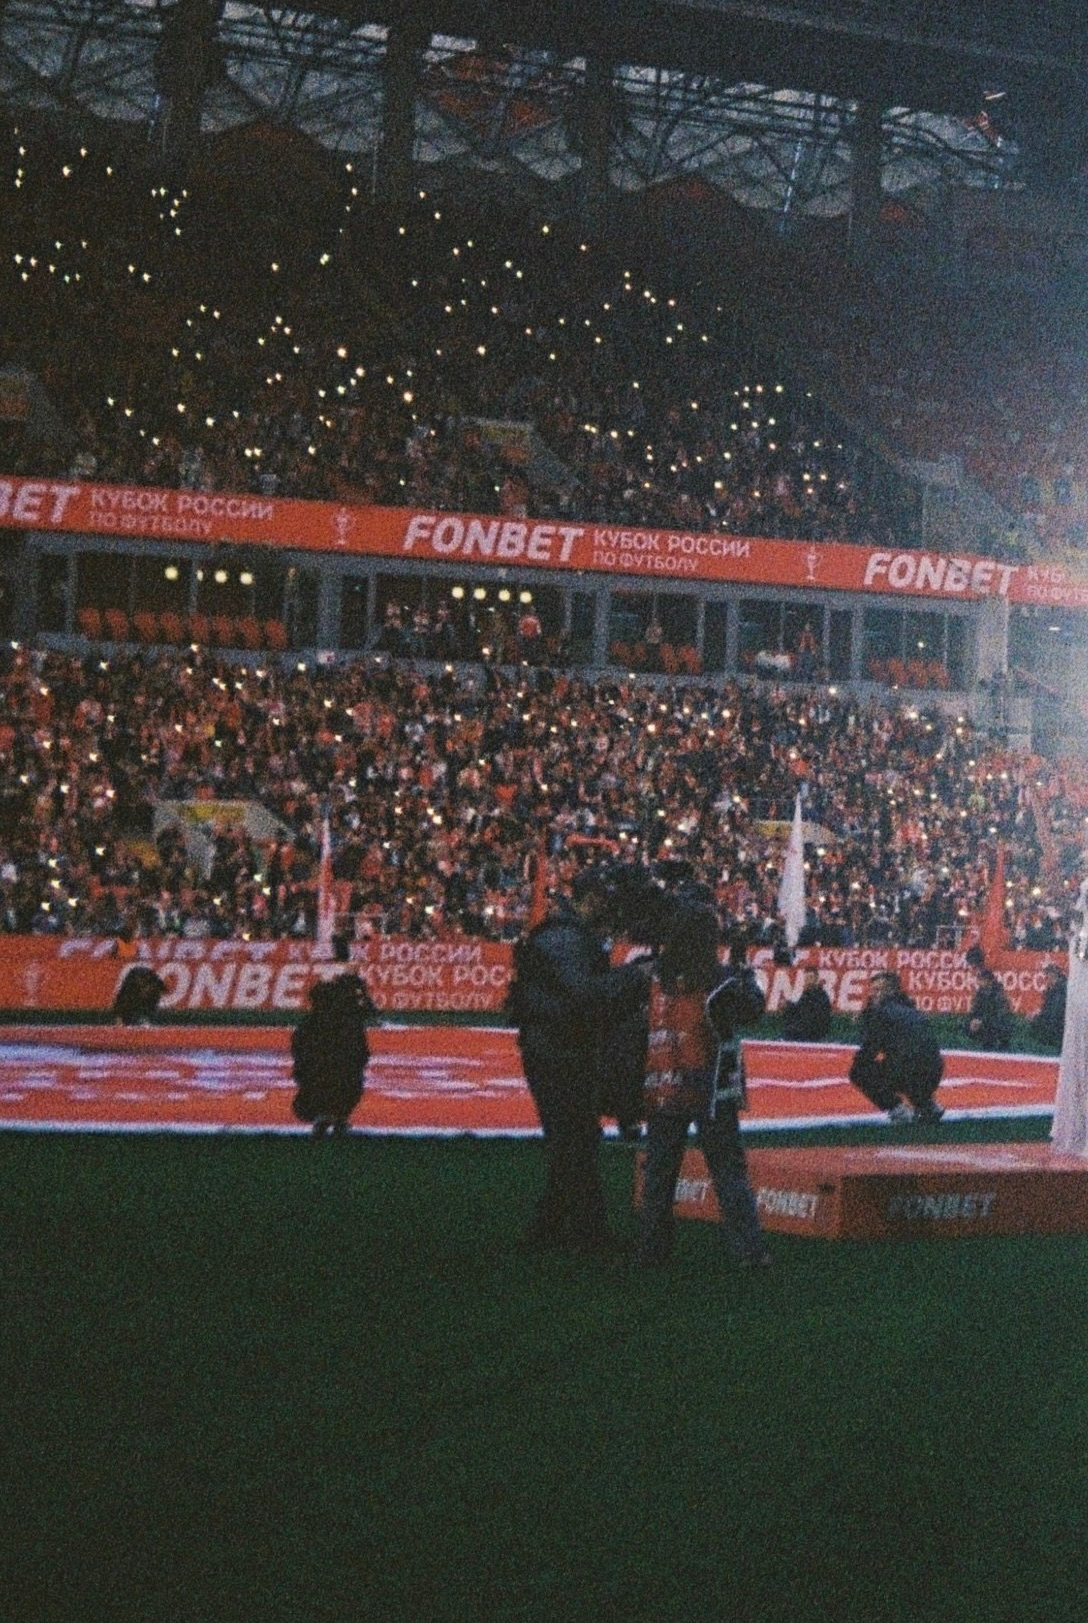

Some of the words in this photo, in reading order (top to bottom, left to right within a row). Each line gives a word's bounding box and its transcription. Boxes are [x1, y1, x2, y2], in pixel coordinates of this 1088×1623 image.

[90, 510, 115, 527] ПО
[91, 487, 169, 512] КУБОК
[177, 494, 274, 521] РОССИИ
[402, 514, 585, 563] FONBET
[594, 528, 660, 552] КУБОК
[667, 534, 751, 558] РОССИИ
[592, 549, 615, 566] ПО
[619, 550, 699, 573] ФУТБОЛУ
[863, 551, 1019, 596] FONBET
[1026, 564, 1064, 584] КУБ
[820, 950, 888, 969] КУБОК
[897, 951, 969, 970] РОССИ
[453, 965, 517, 986] РОС
[756, 1186, 819, 1219] FONBET
[887, 1190, 997, 1221] FONBET
